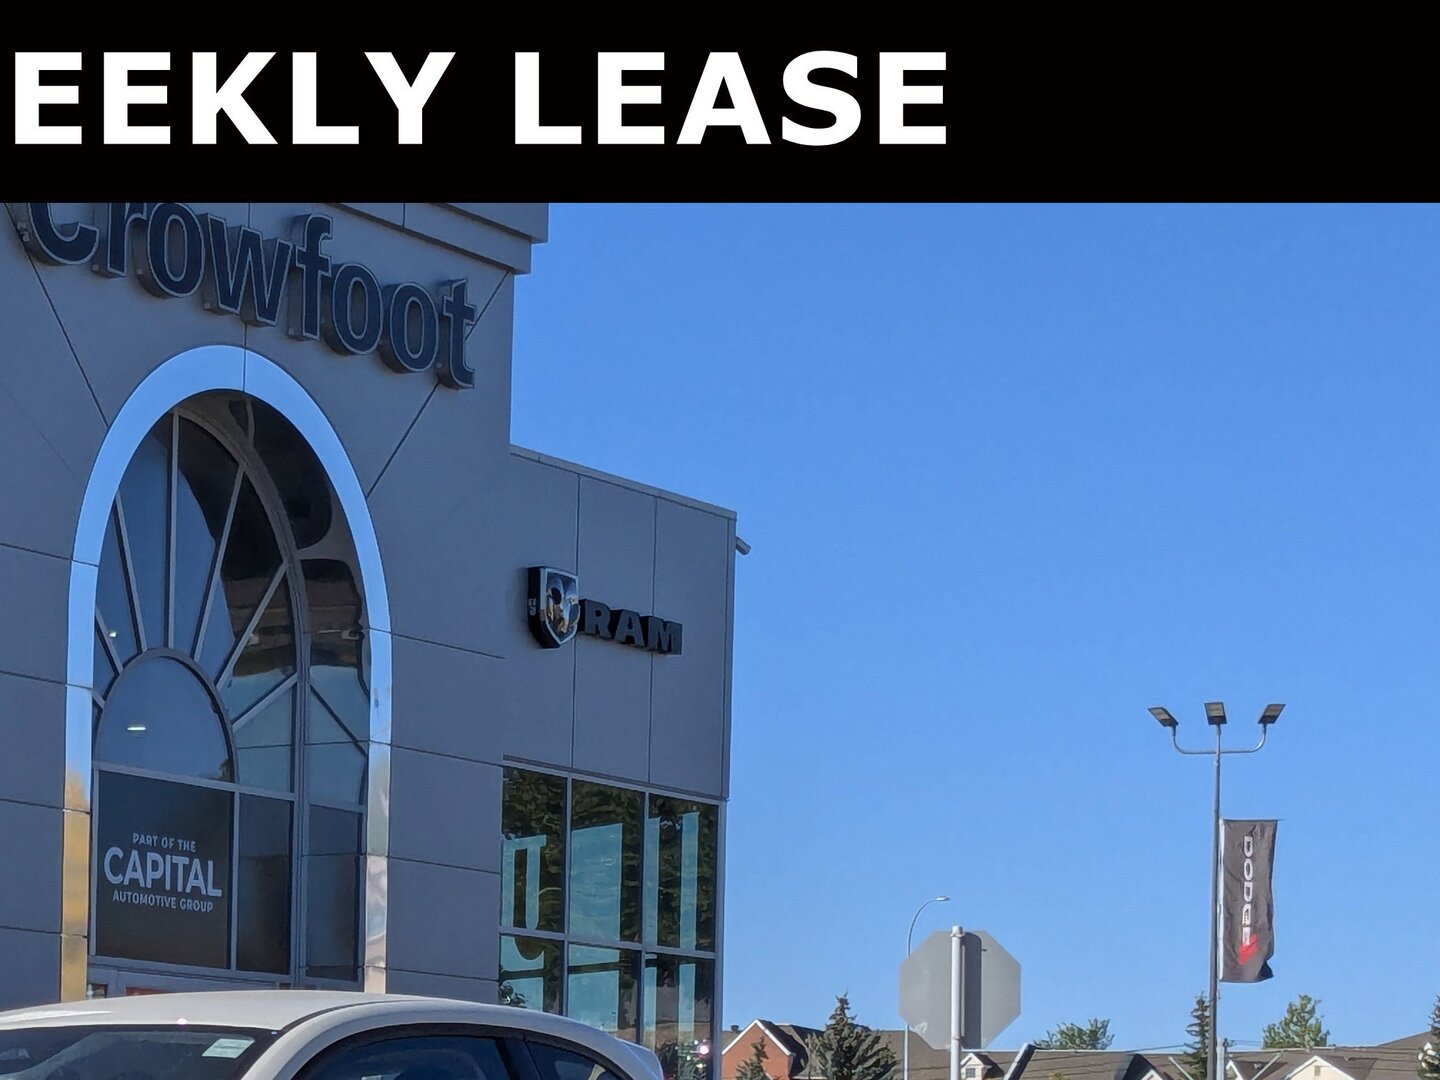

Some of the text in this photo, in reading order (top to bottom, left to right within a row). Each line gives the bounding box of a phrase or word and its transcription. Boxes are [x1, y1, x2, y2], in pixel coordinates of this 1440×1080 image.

[580, 599, 683, 656] RAM
[133, 833, 196, 852] PART OF THE
[104, 846, 222, 897] CAPITAL
[1242, 836, 1254, 947] DODGE
[113, 889, 214, 913] AUTOMOTIVE GROUP
